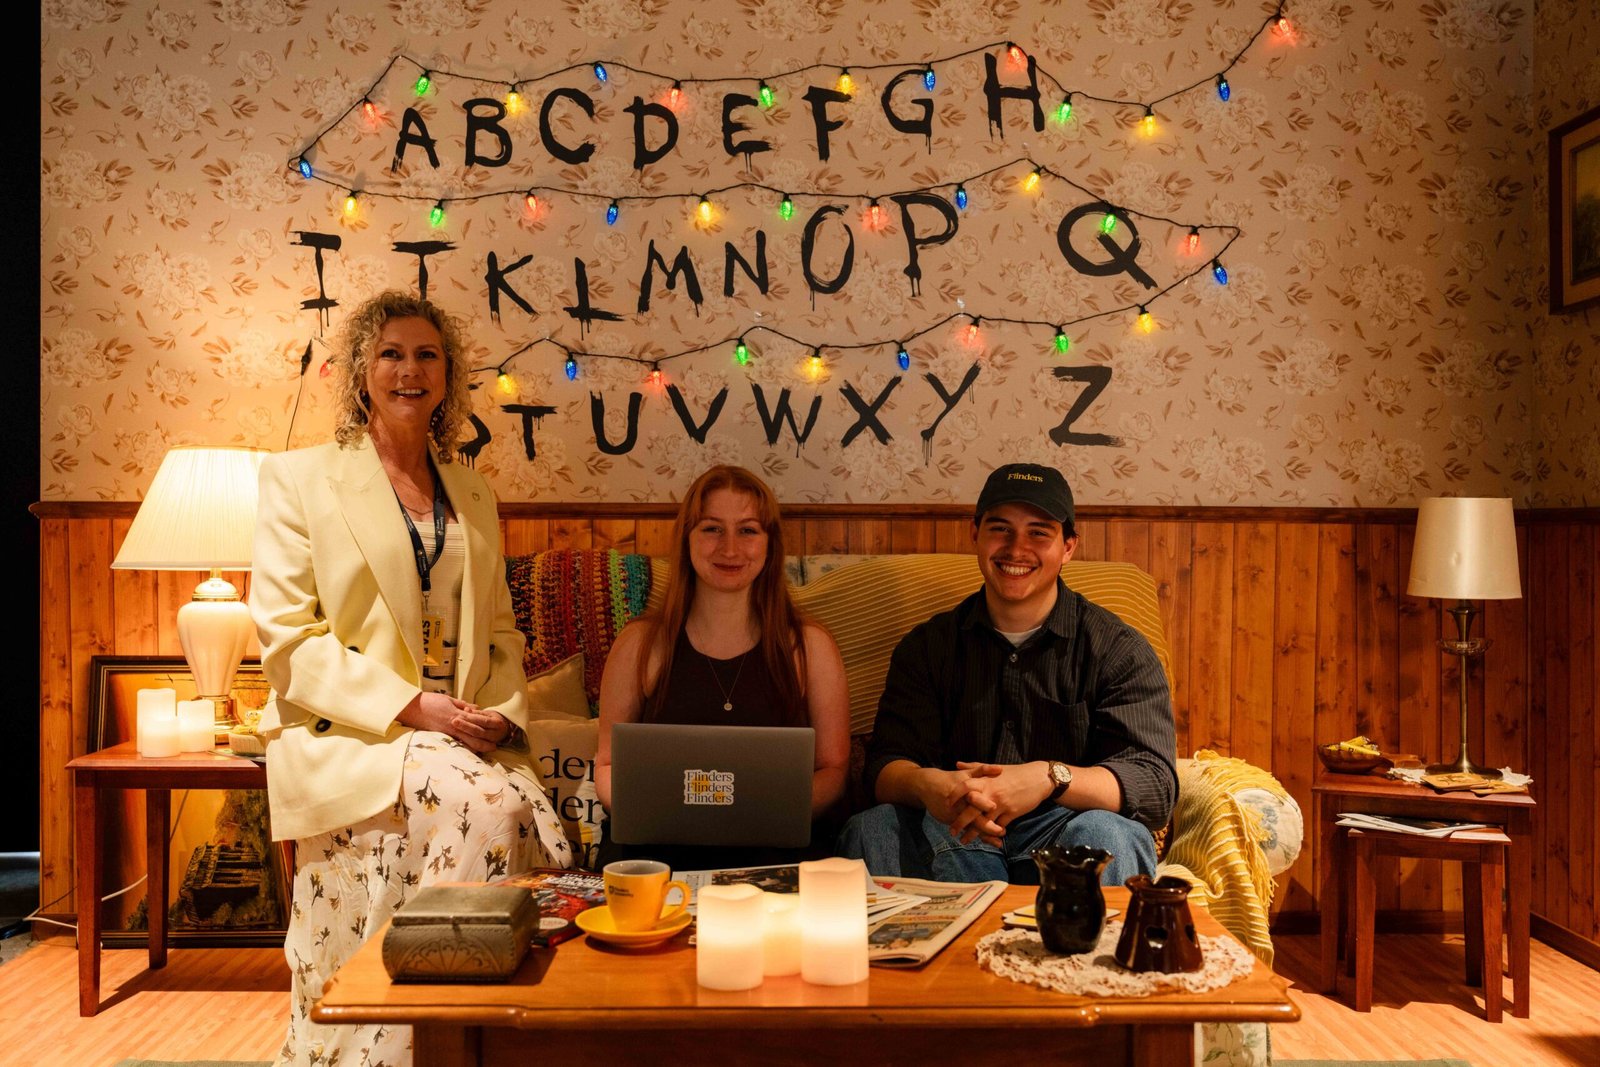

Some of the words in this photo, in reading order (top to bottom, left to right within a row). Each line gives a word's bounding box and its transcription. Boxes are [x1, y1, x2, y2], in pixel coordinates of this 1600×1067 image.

[391, 107, 441, 173] A
[462, 98, 514, 168] B
[538, 88, 597, 165] C
[623, 96, 680, 171] D
[721, 93, 774, 168] E
[801, 85, 852, 162] F
[880, 69, 934, 150] G
[983, 52, 1045, 139] H
[484, 250, 540, 322] K
[562, 257, 626, 330] L
[637, 239, 704, 317] M
[723, 229, 769, 298] N
[890, 192, 959, 297] P
[1056, 201, 1158, 290] Q
[500, 403, 558, 462] T
[590, 390, 643, 456] U
[664, 383, 730, 444] V
[751, 383, 823, 457] W
[838, 375, 902, 448] X
[920, 359, 982, 466] Y
[1048, 365, 1126, 448] Z
[1007, 472, 1044, 483] Flinders
[686, 771, 733, 782] Flinders
[686, 782, 733, 793] Flinders
[686, 793, 733, 803] Flinders
